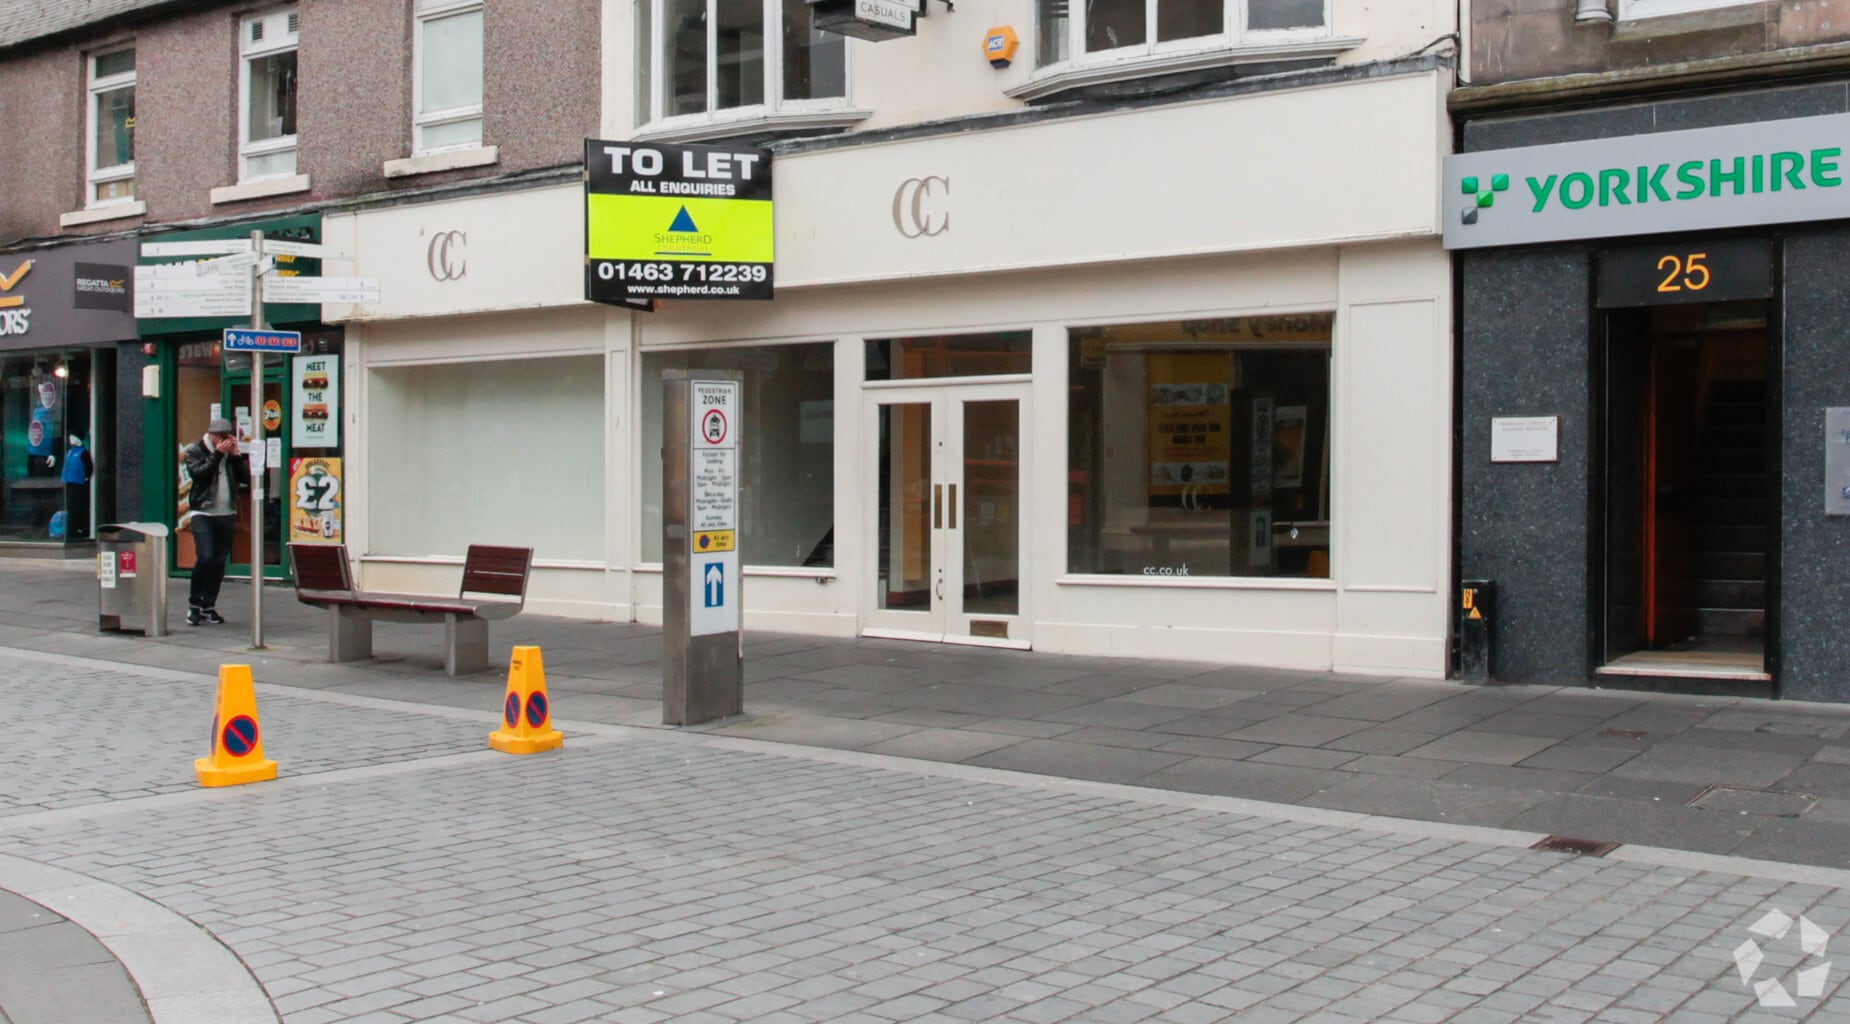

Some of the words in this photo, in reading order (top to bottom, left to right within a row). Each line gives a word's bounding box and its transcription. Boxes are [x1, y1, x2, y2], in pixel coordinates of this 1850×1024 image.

[860, 2, 906, 22] CASUALS
[603, 147, 663, 176] TO
[682, 151, 759, 180] LET
[630, 180, 656, 193] ALL
[660, 181, 736, 196] ENQUIRIES
[1526, 147, 1842, 213] YORKSHIRE
[892, 175, 950, 239] CC
[427, 229, 467, 282] CC
[598, 262, 674, 280] 01463
[680, 264, 766, 282] 712239
[1657, 253, 1711, 293] 25
[76, 278, 109, 287] REGATTA
[627, 284, 740, 296] www.shepherd.co.uk
[306, 361, 326, 371] MEET
[308, 392, 323, 402] THE
[703, 395, 727, 405] ZONE
[306, 423, 326, 432] MEAT
[296, 475, 339, 510] £2
[1143, 563, 1189, 577] cc.co.uk
